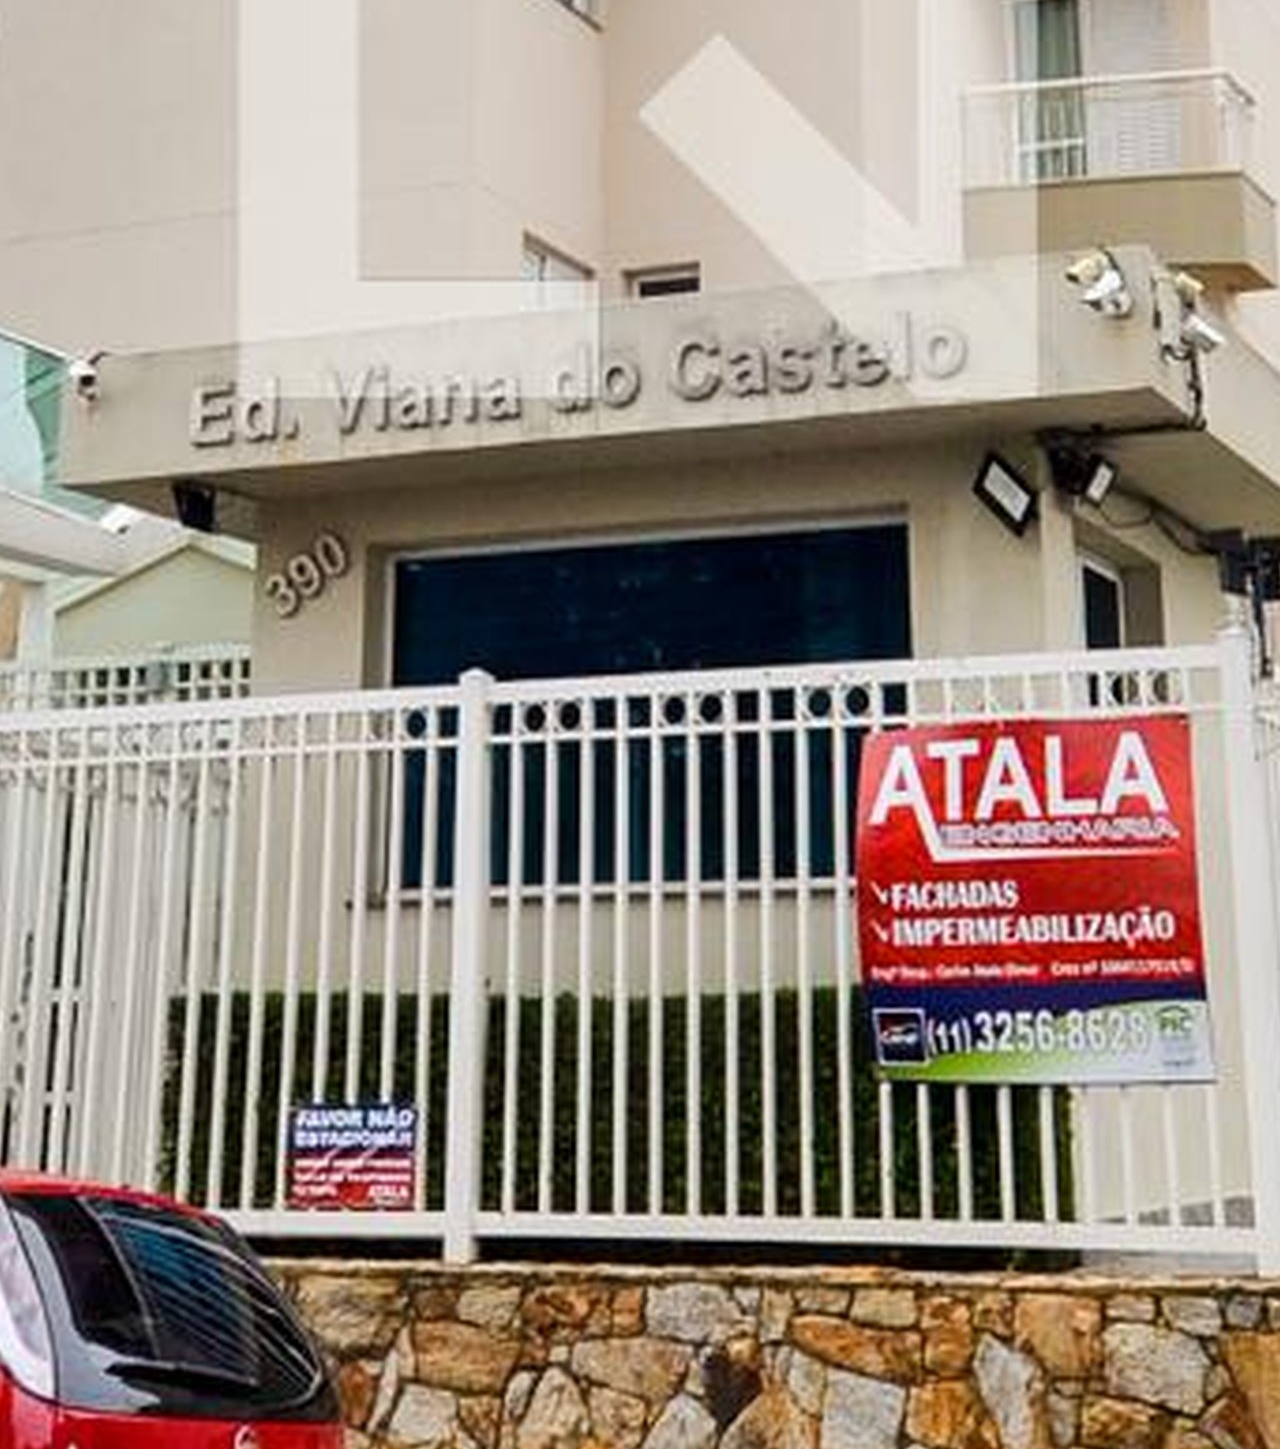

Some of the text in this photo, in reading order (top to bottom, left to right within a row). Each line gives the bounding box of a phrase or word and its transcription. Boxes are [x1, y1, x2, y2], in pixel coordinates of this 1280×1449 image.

[188, 309, 969, 448] Ed. Viana do Castelo
[265, 531, 351, 619] 390
[868, 729, 1170, 826] ATALA
[890, 879, 1020, 912] FACHADAS
[892, 905, 1177, 950] IMPERMEABILIZAÇÃO
